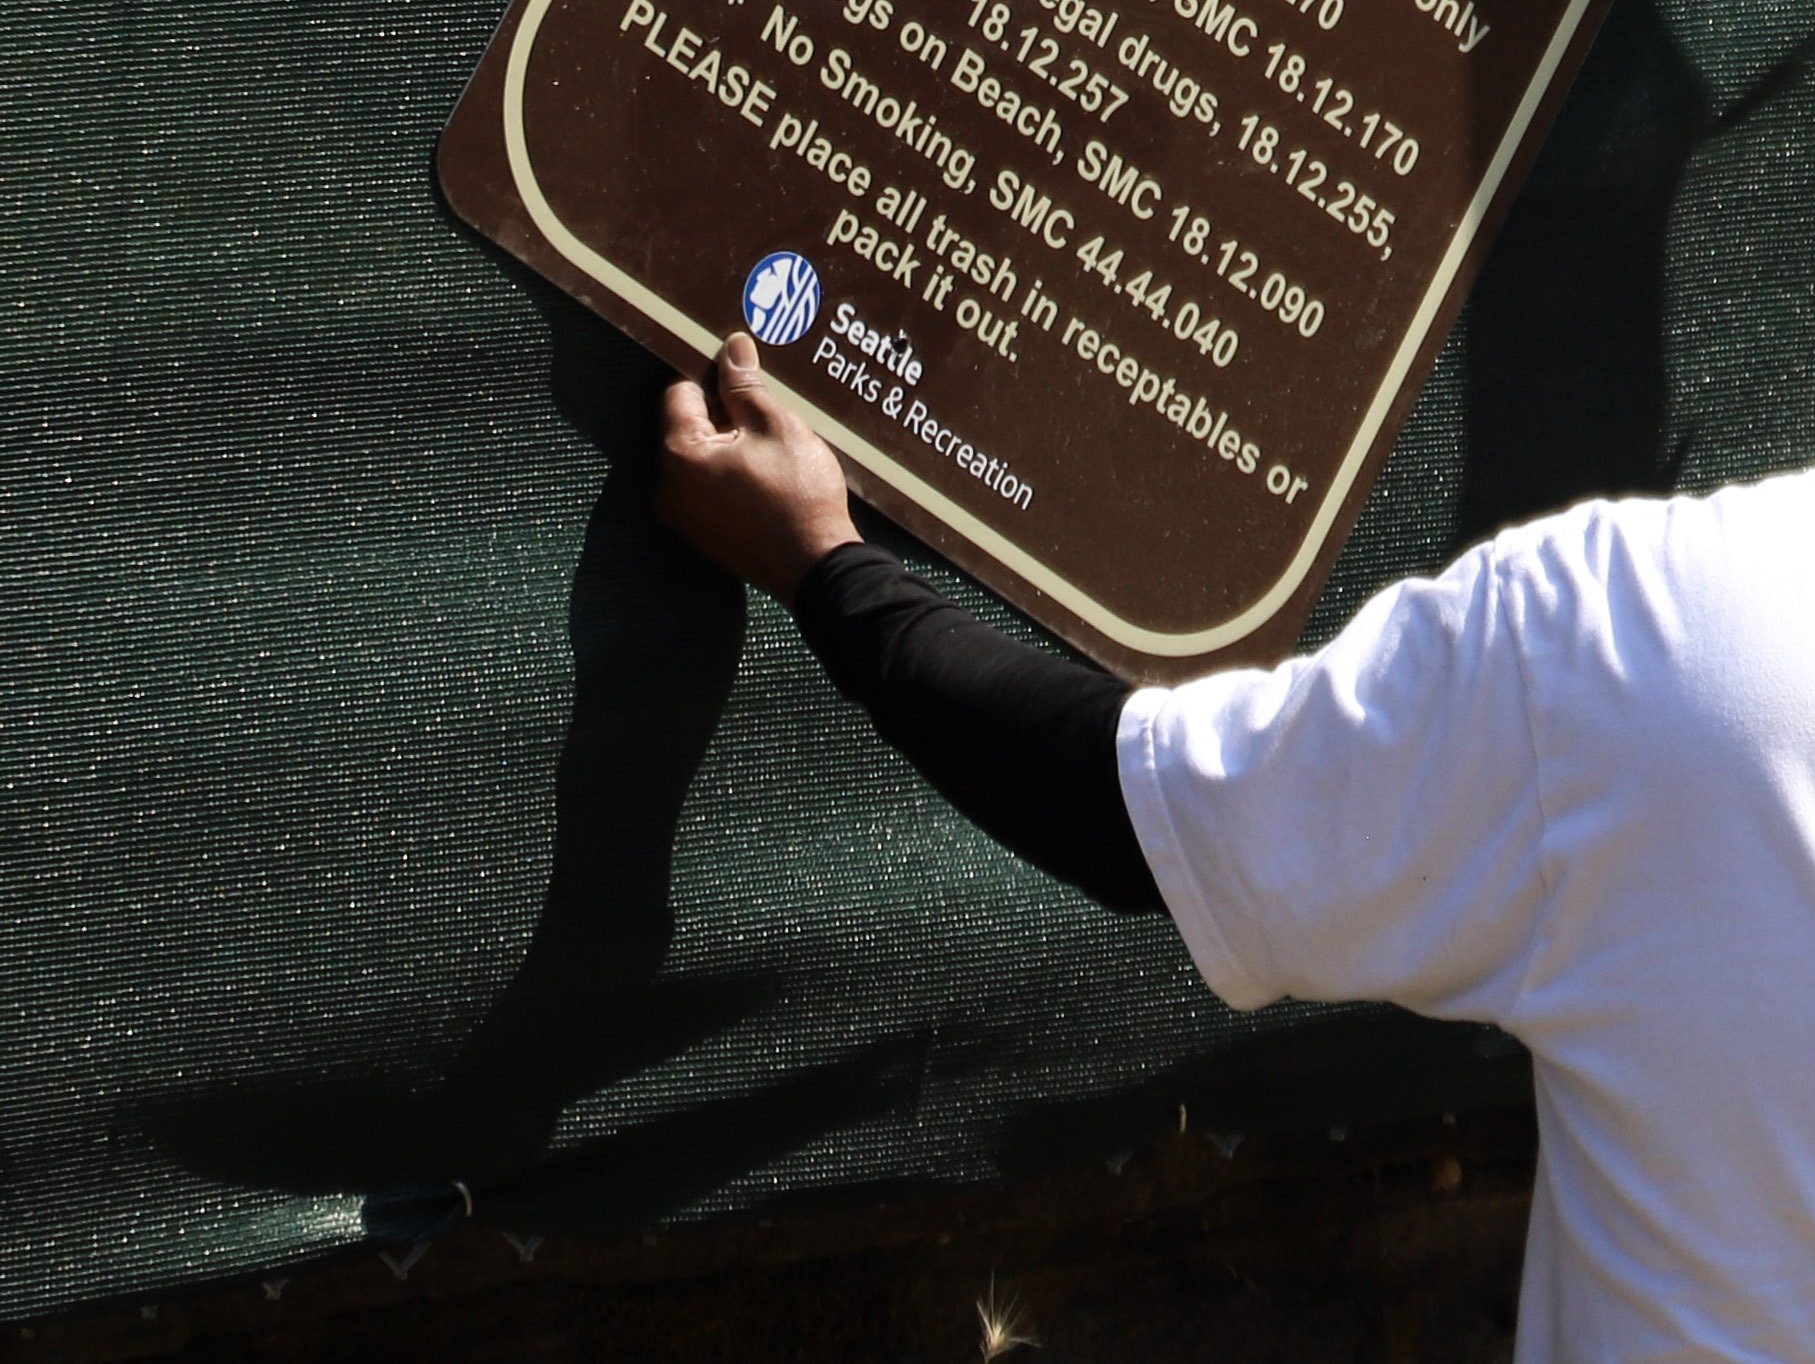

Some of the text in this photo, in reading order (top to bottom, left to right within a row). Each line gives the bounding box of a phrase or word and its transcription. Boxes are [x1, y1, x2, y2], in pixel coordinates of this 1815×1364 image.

[761, 4, 1238, 367] No Smoking, SMC 44.44.040
[900, 22, 946, 70] on
[951, 48, 1064, 165] Beach,
[1077, 140, 1161, 219] SMC
[1169, 205, 1324, 337] 18.12.090
[1119, 34, 1221, 137] drugs,
[1238, 114, 1395, 261] 18.12.255,
[1265, 43, 1419, 175] 18.12.170
[770, 113, 871, 196] place
[876, 187, 927, 233] all
[927, 215, 1016, 302] trash
[1021, 279, 1057, 331] in
[1062, 317, 1260, 474] receptables
[1266, 464, 1308, 504] or
[827, 209, 1018, 362] pack it out.
[813, 336, 1032, 510] Parks & Recreation
